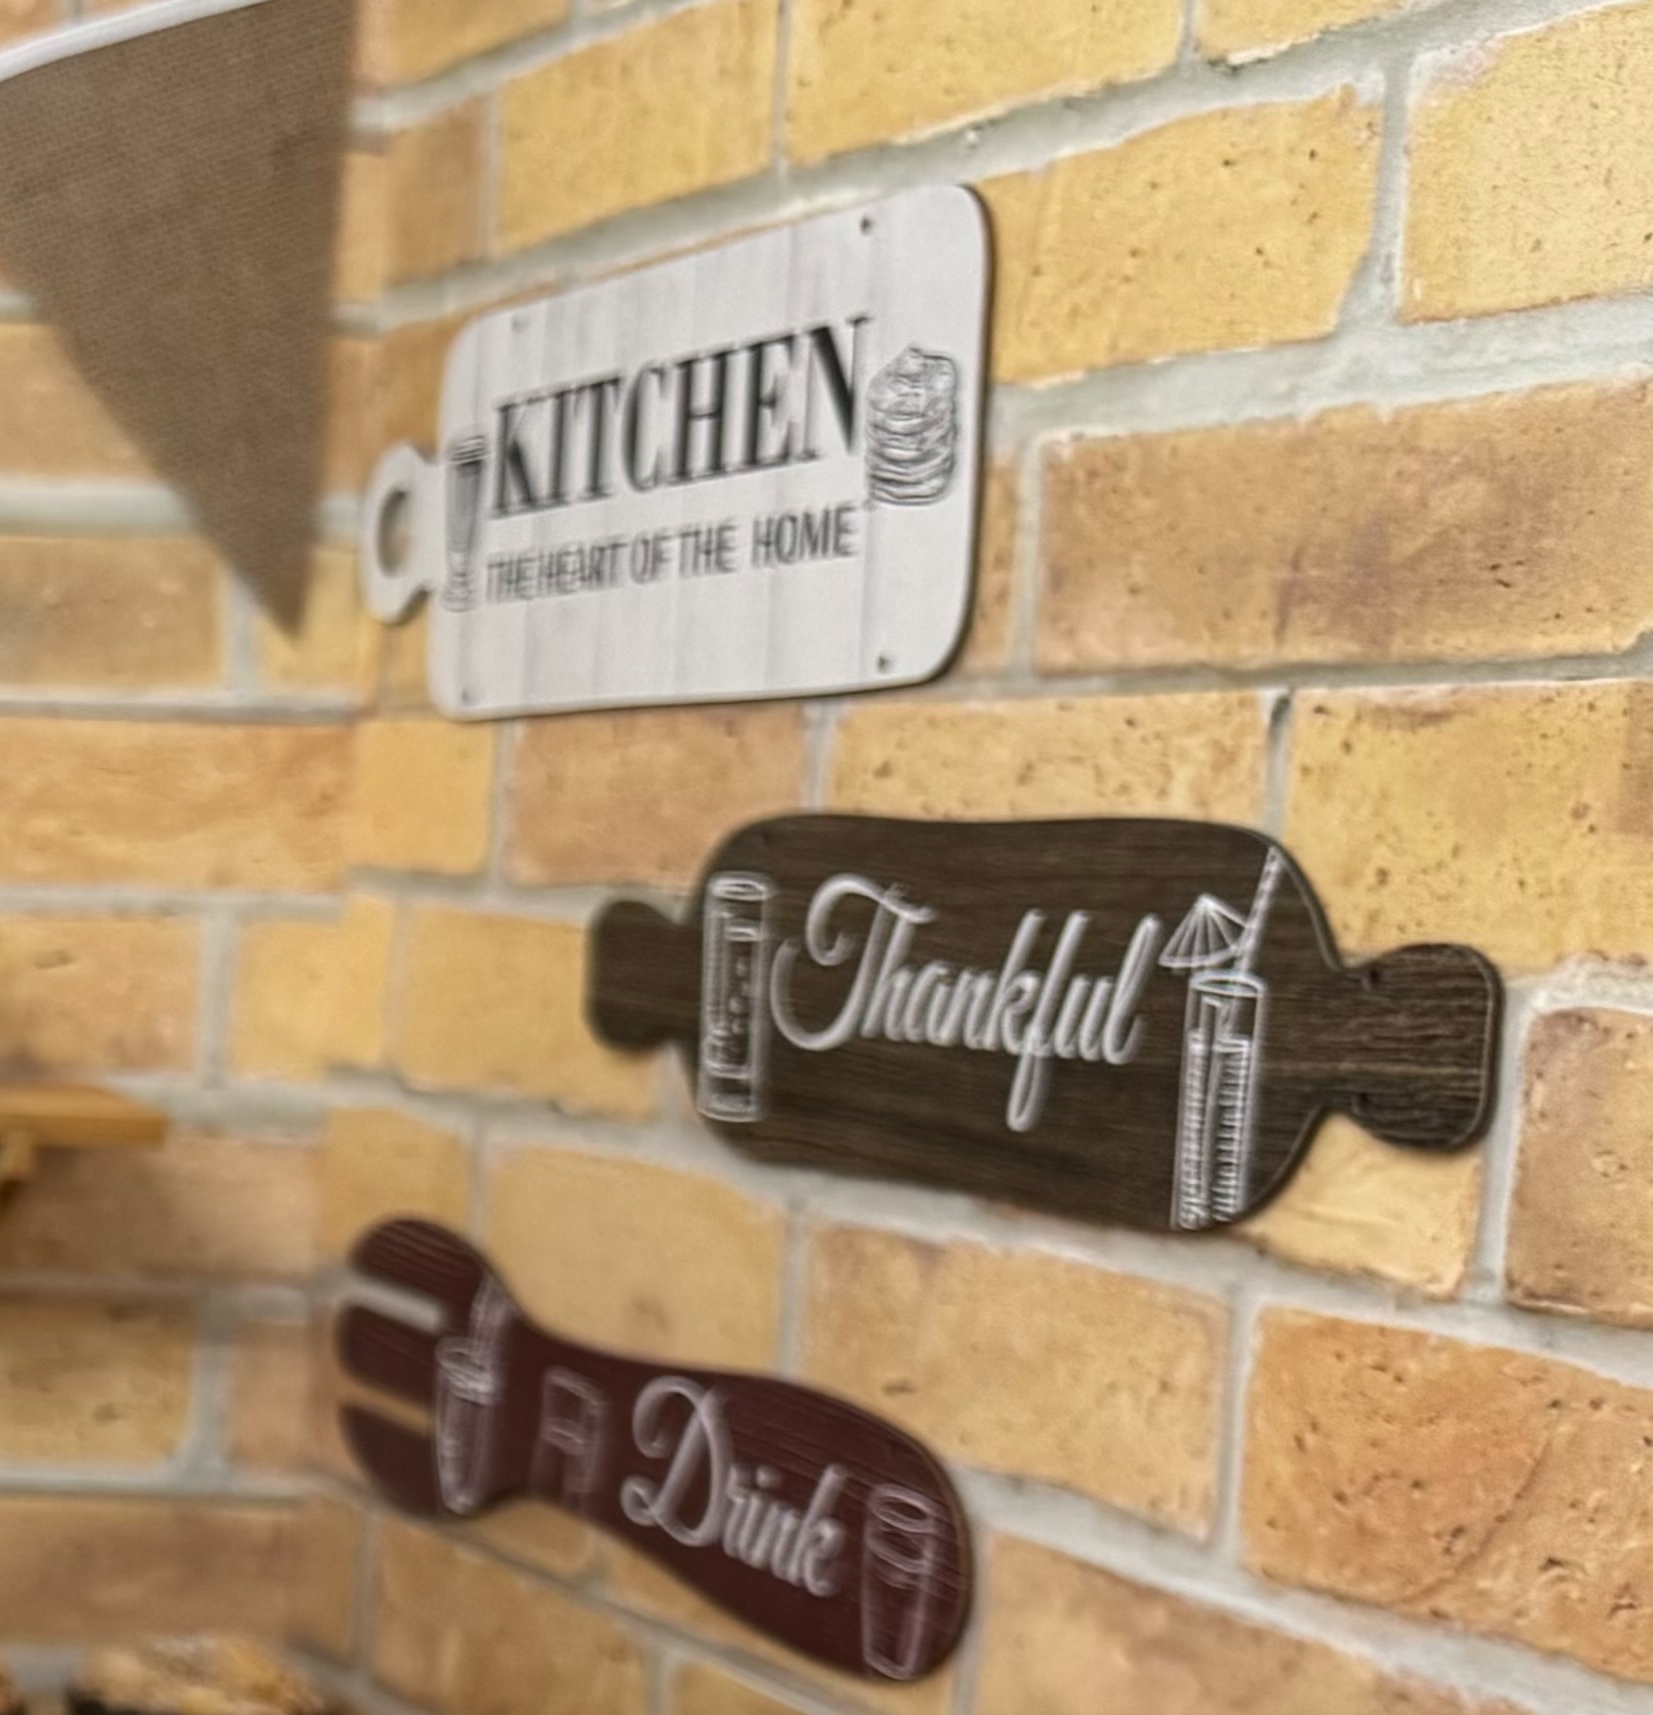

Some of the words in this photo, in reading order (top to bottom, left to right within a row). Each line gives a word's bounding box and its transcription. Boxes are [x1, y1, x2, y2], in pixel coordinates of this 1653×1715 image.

[494, 312, 874, 520] KITCHEN
[487, 545, 537, 603] THE
[537, 532, 630, 597] HEART
[629, 530, 679, 584] OF
[678, 516, 738, 577] THE
[752, 498, 860, 568] HOME
[770, 873, 1160, 1132] Thankful
[620, 1376, 848, 1597] Drink
